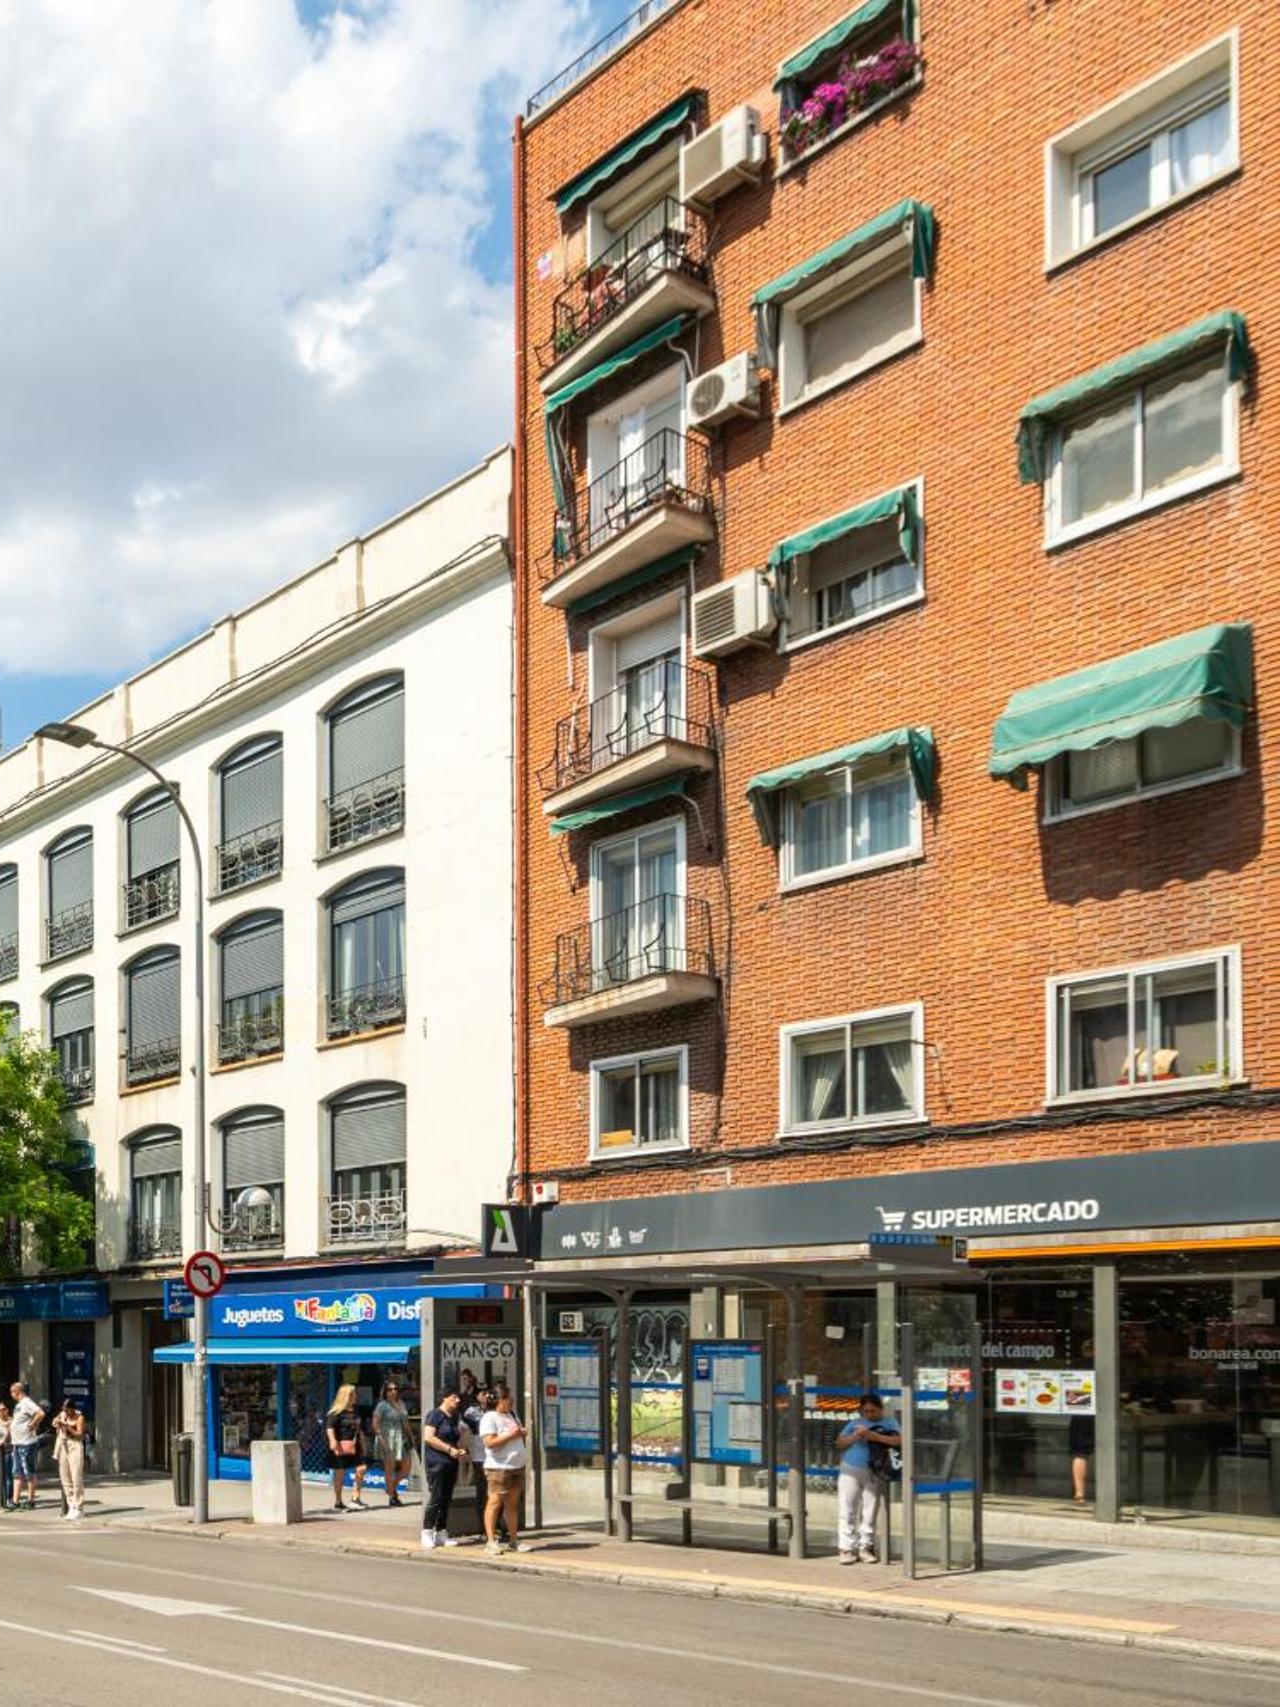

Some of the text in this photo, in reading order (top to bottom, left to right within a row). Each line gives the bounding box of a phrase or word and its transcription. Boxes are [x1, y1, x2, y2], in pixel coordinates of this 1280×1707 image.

[911, 1199, 1100, 1230] SUPERMERCADO
[223, 1307, 284, 1327] Juguetes
[443, 1341, 514, 1359] MANGO
[981, 1341, 1003, 1358] del
[1006, 1344, 1055, 1361] campo
